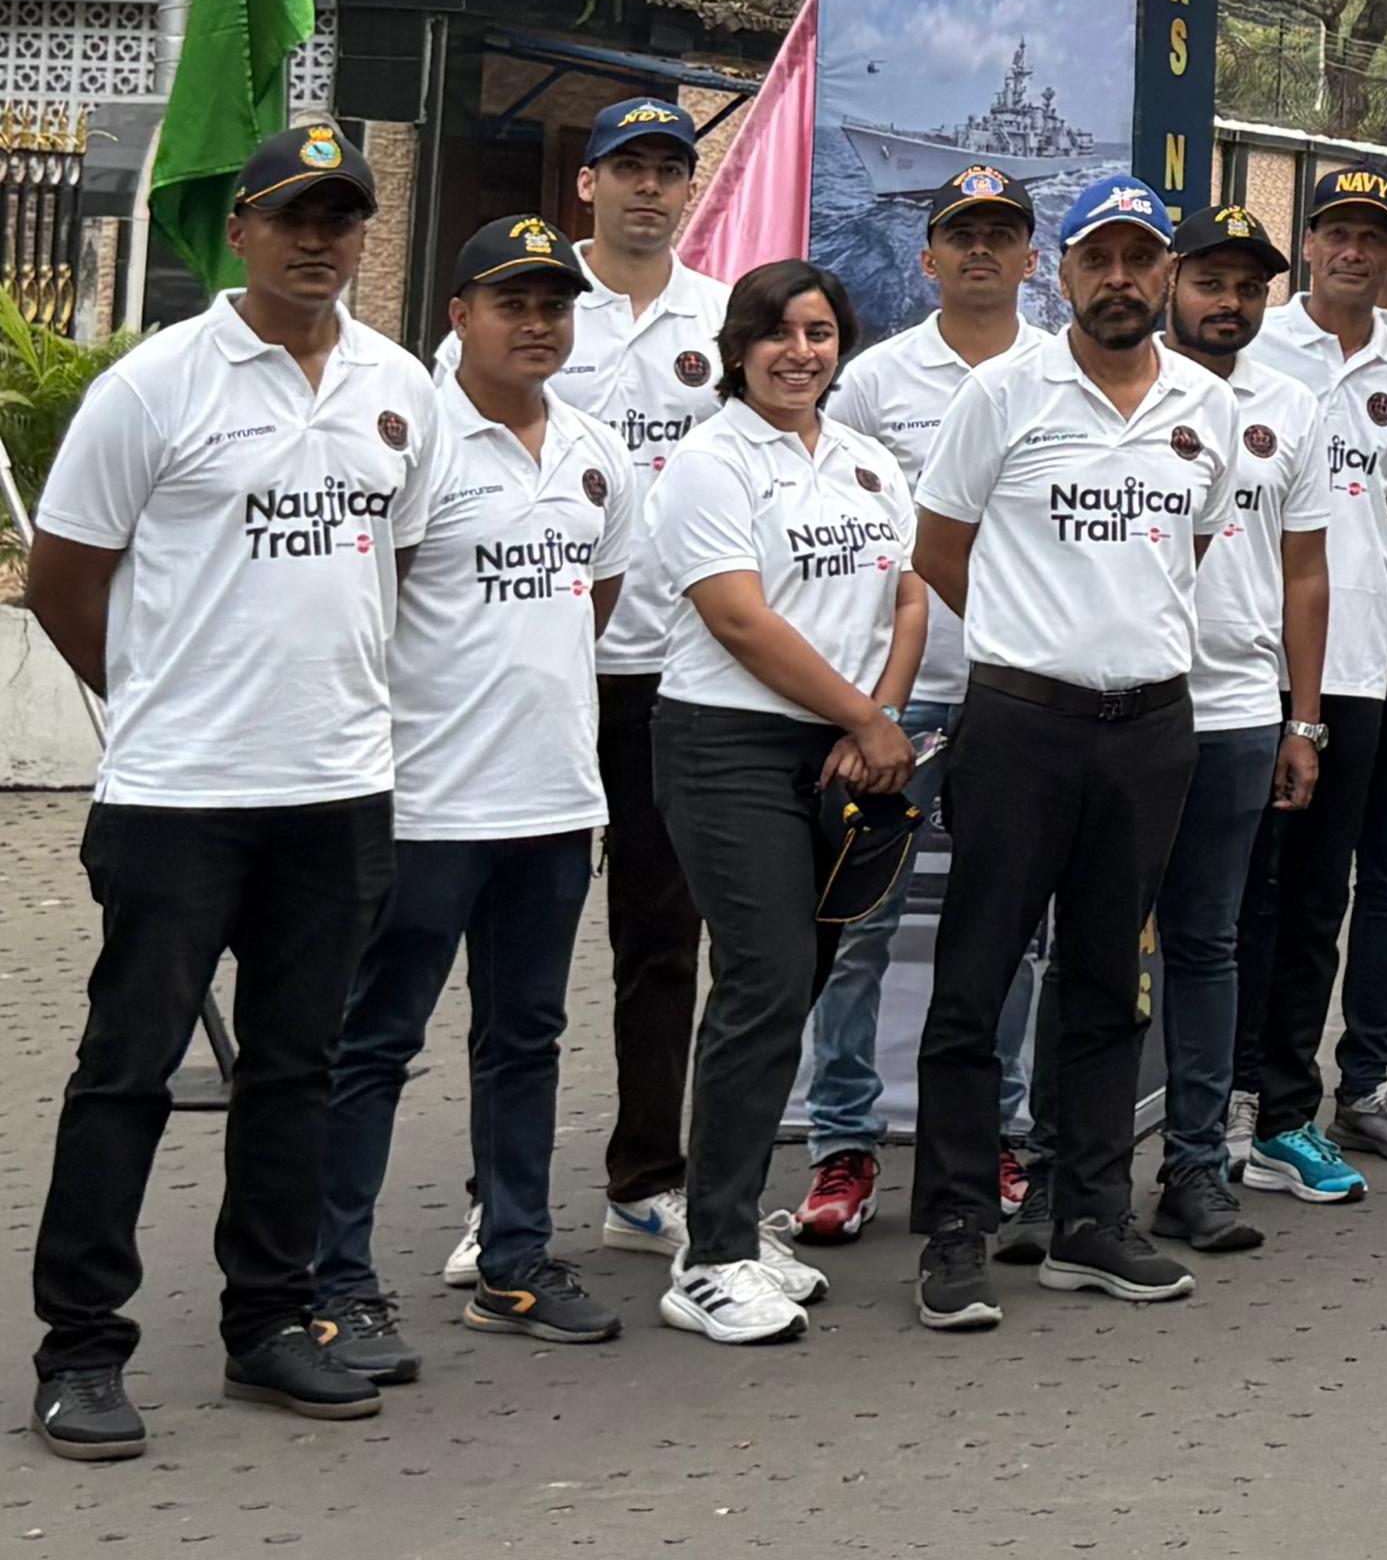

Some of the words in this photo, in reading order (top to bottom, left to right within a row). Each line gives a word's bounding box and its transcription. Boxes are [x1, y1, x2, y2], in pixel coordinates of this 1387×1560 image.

[1051, 477, 1191, 519] Nautical
[246, 521, 332, 559] Trail
[1051, 513, 1126, 541] Trail
[794, 547, 855, 581] Trail
[477, 568, 552, 603] Trail
